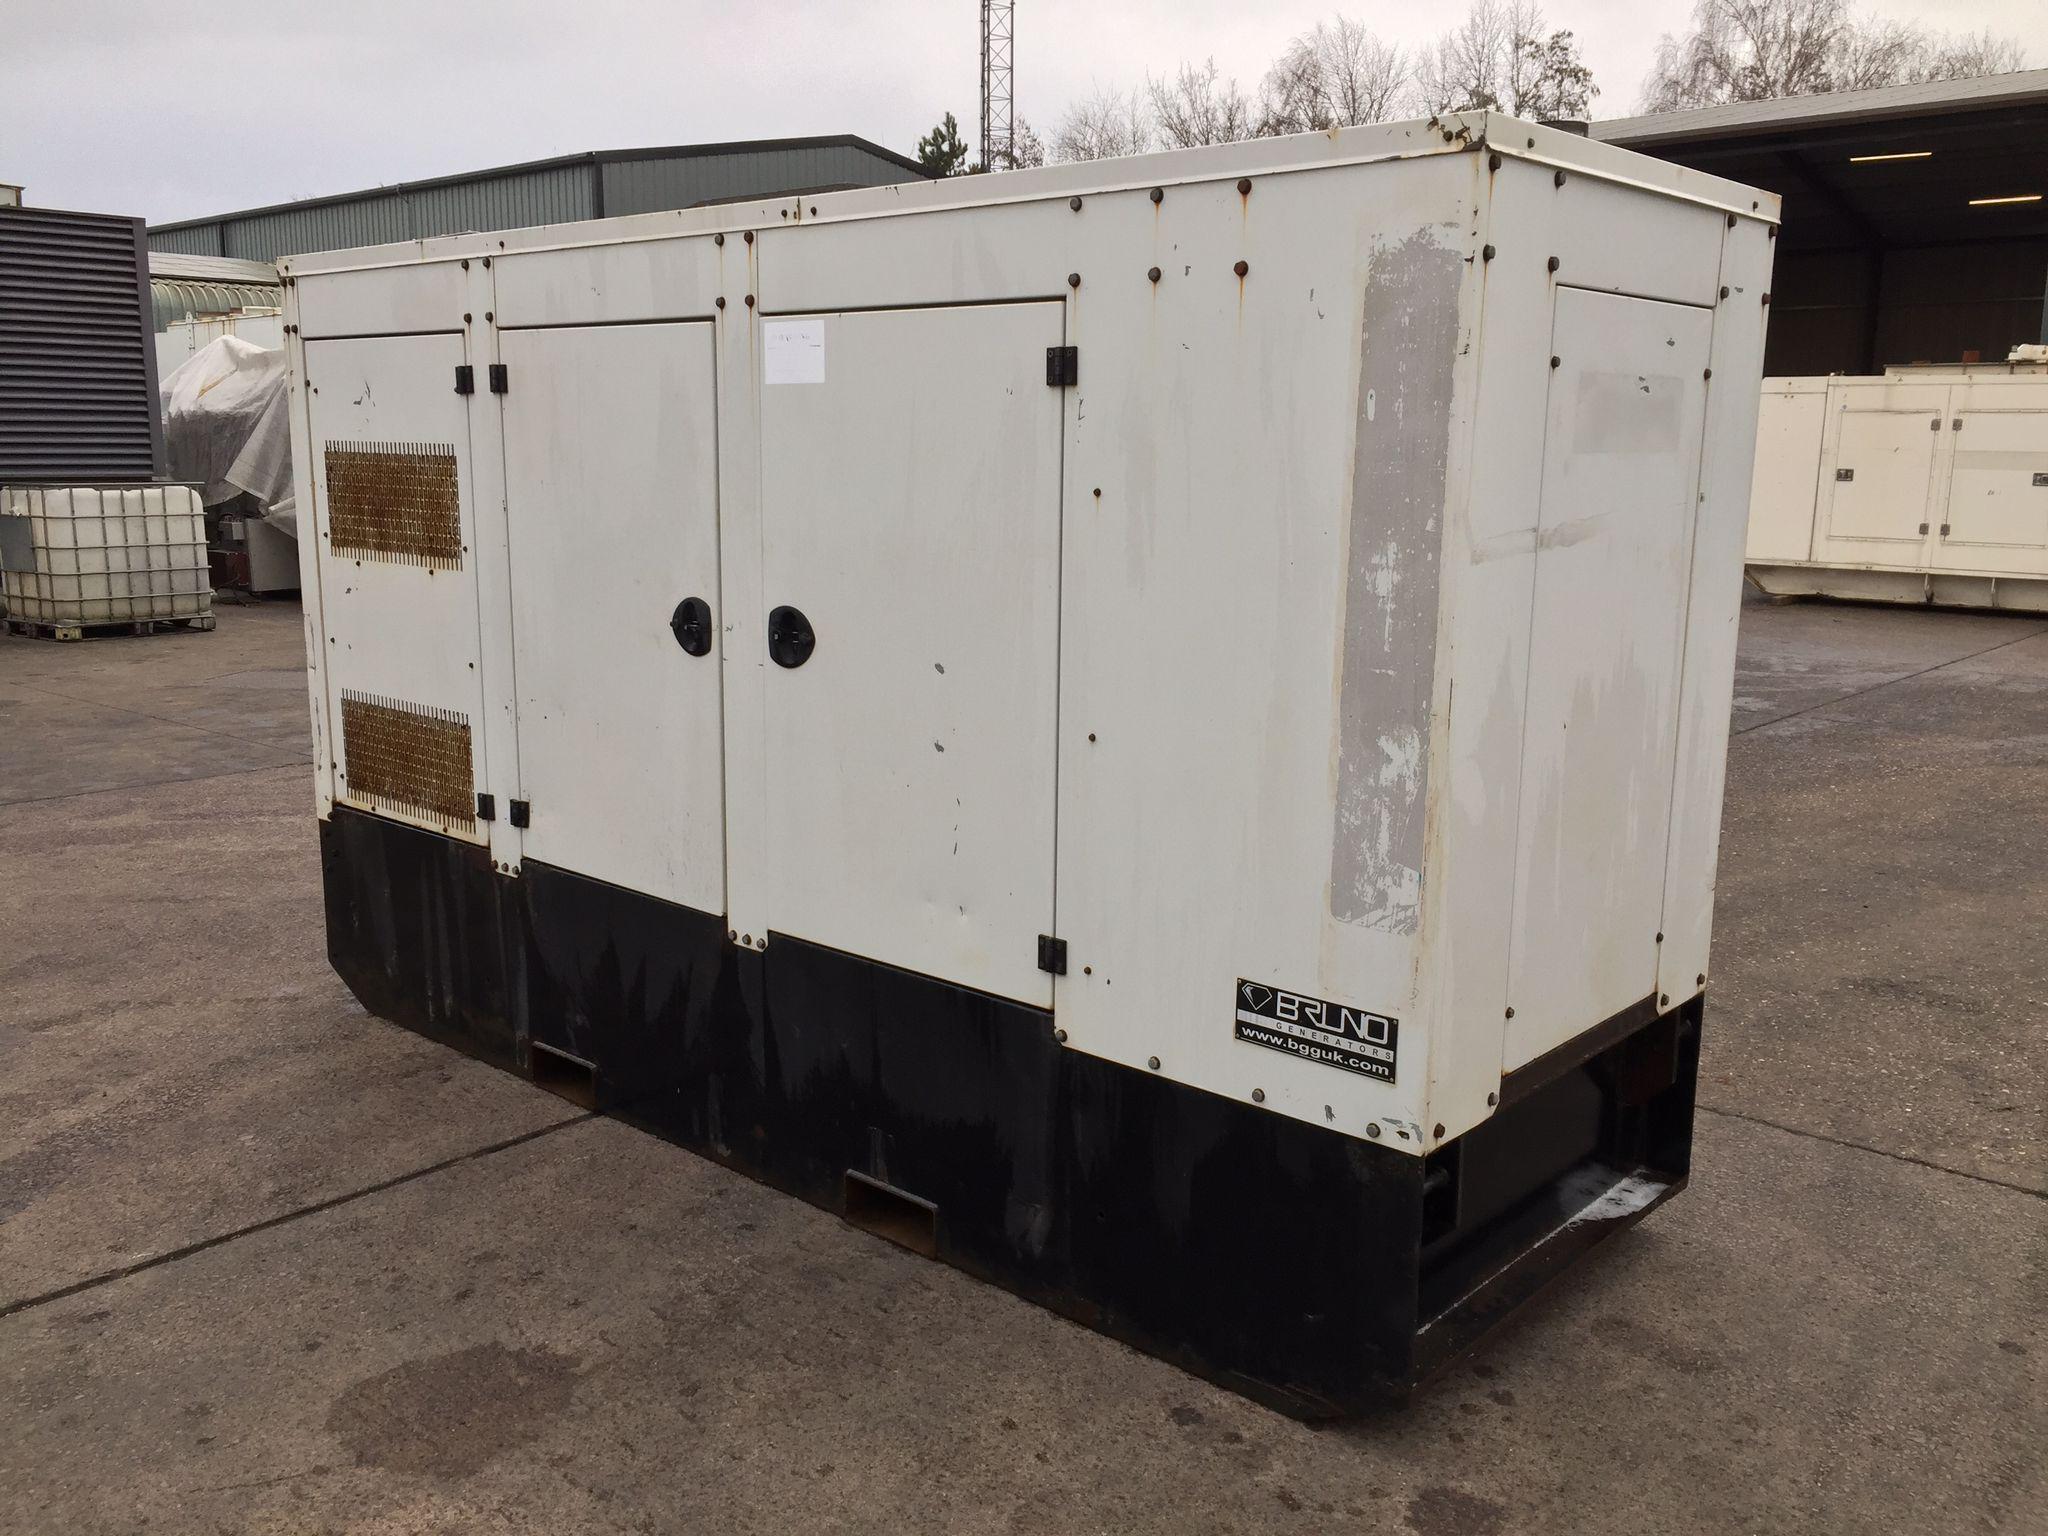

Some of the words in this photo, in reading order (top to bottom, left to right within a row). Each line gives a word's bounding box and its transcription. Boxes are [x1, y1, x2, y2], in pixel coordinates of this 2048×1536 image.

[1276, 991, 1389, 1045] BRUNO
[1276, 1022, 1391, 1060] GENERATORS
[1241, 1026, 1390, 1076] www.bgguk.com
